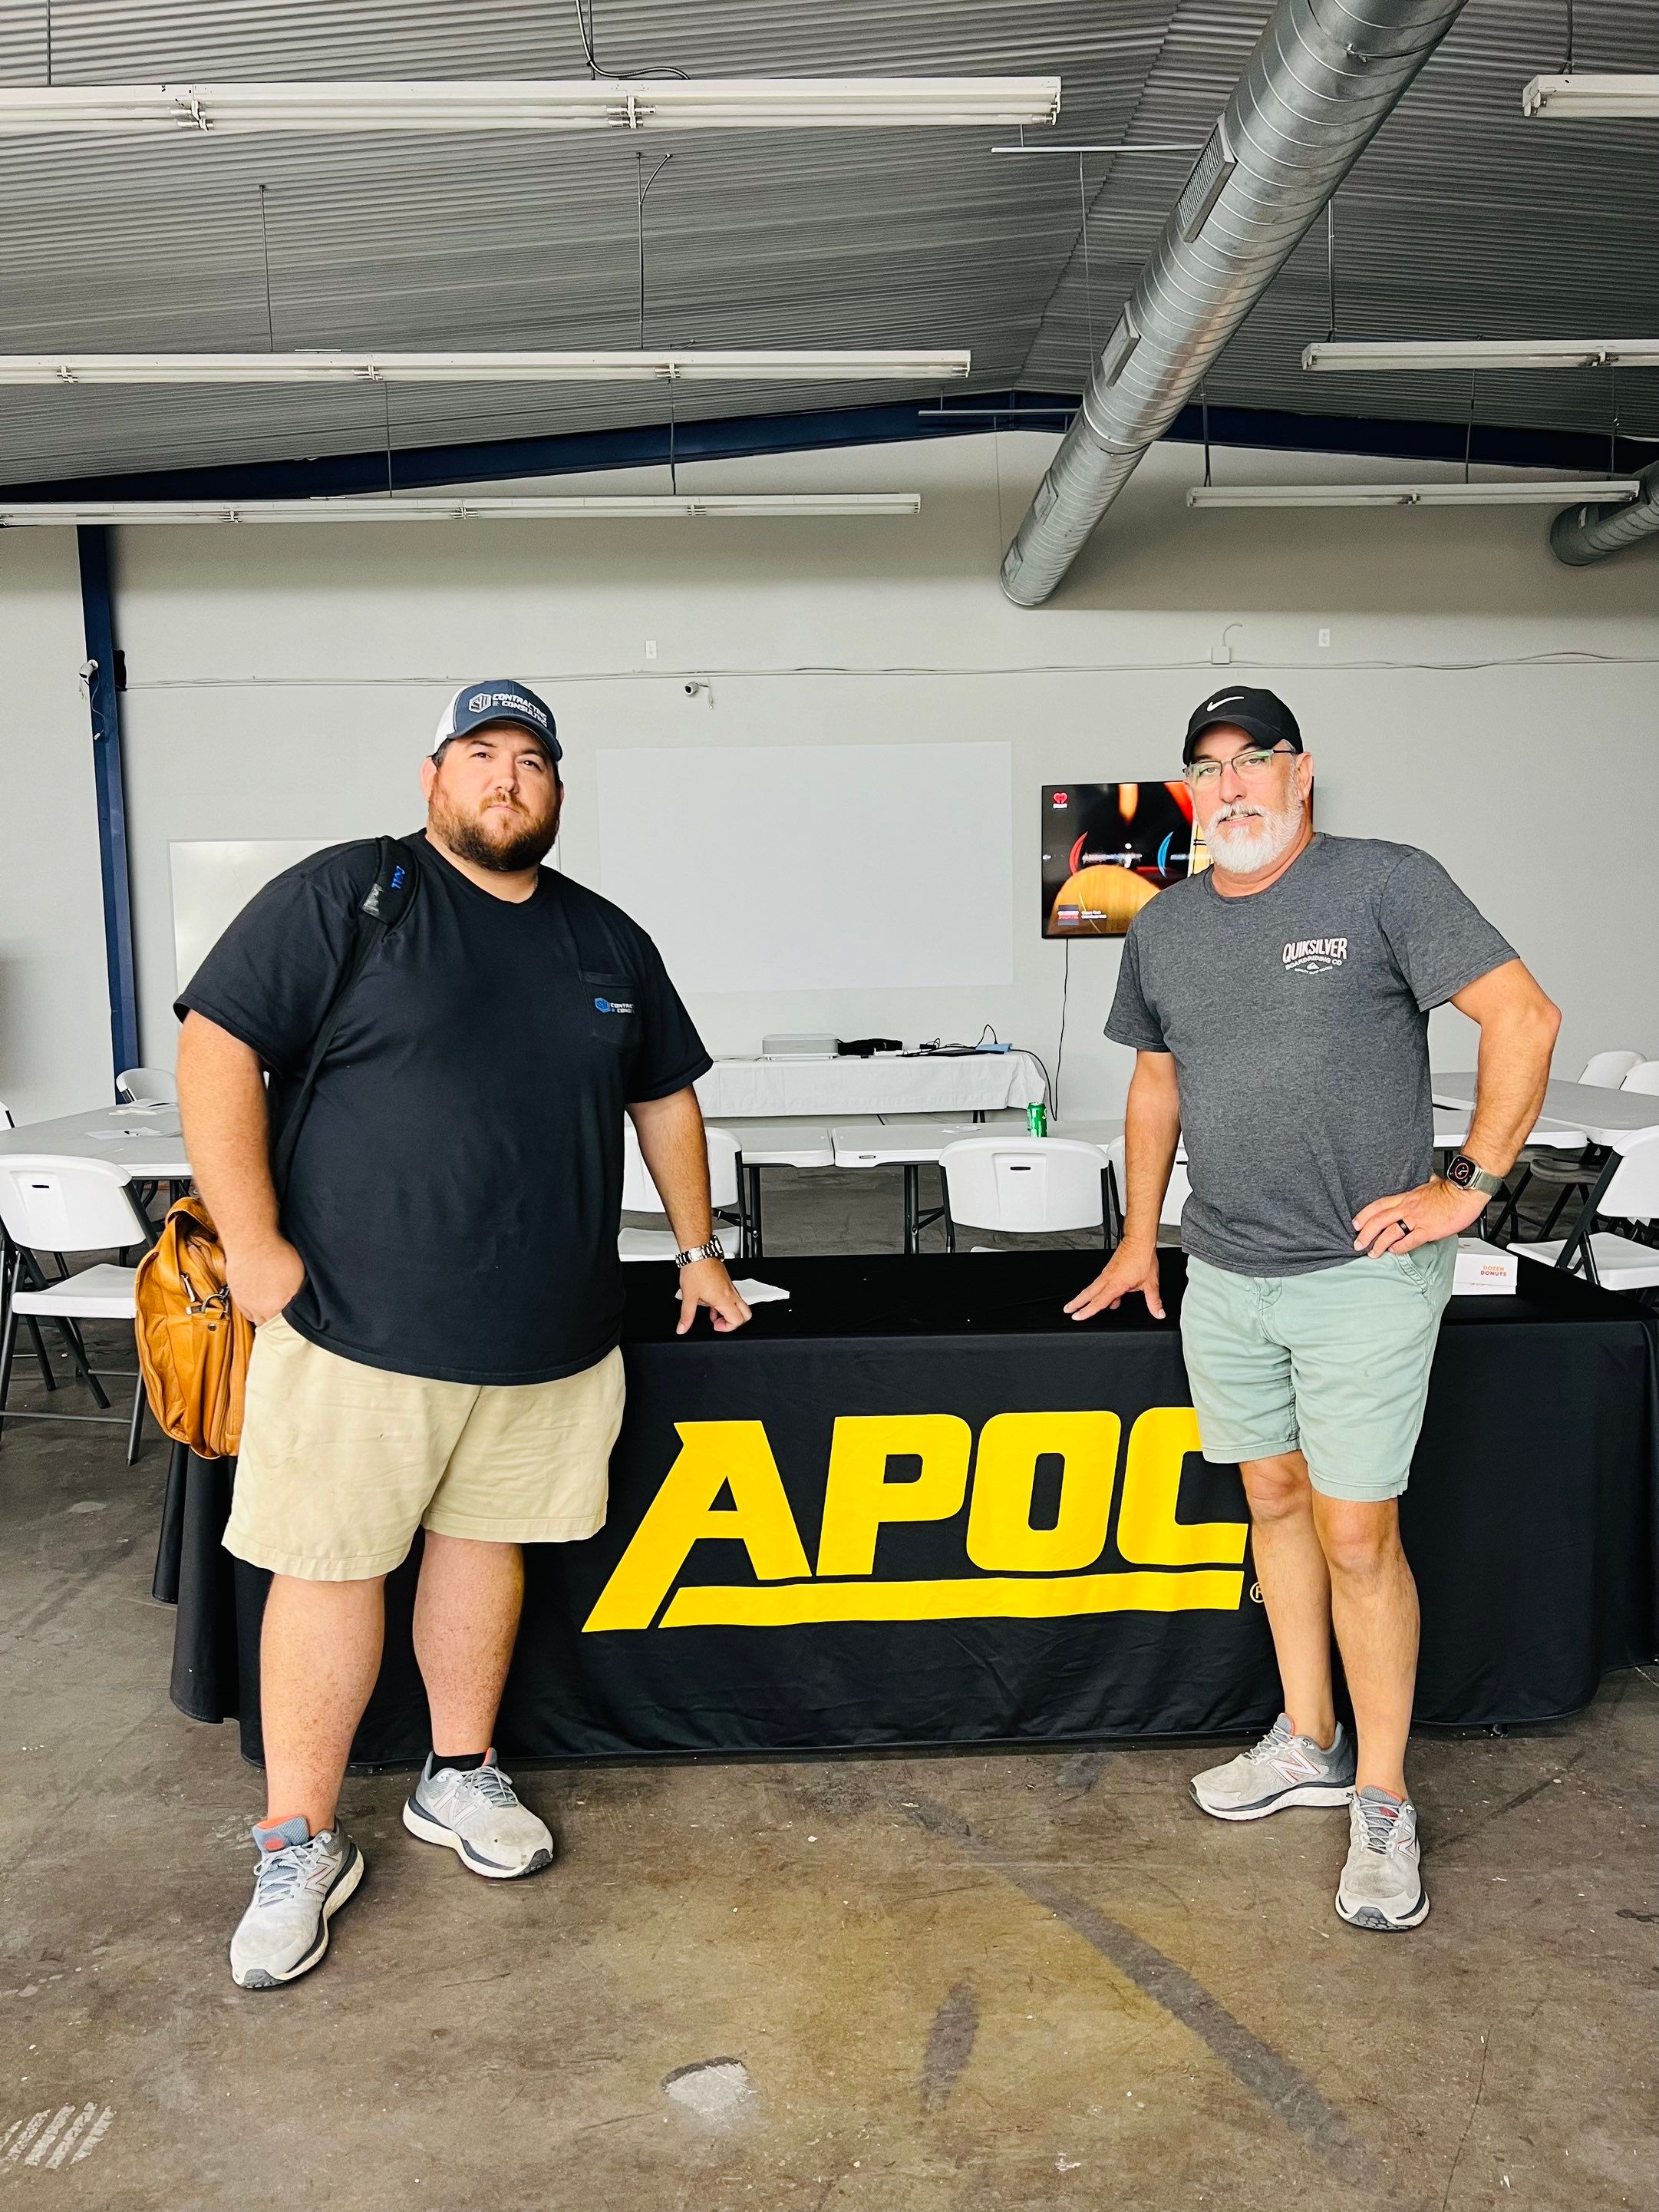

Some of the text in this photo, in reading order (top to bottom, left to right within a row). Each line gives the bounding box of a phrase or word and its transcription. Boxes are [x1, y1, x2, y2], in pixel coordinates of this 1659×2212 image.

[492, 693, 547, 721] CONTRACTING
[501, 701, 548, 728] CONSULTING
[1282, 937, 1348, 964] QUIKSILVER
[1285, 955, 1331, 971] BOARDRIDING
[581, 1407, 1249, 1633] APOC
